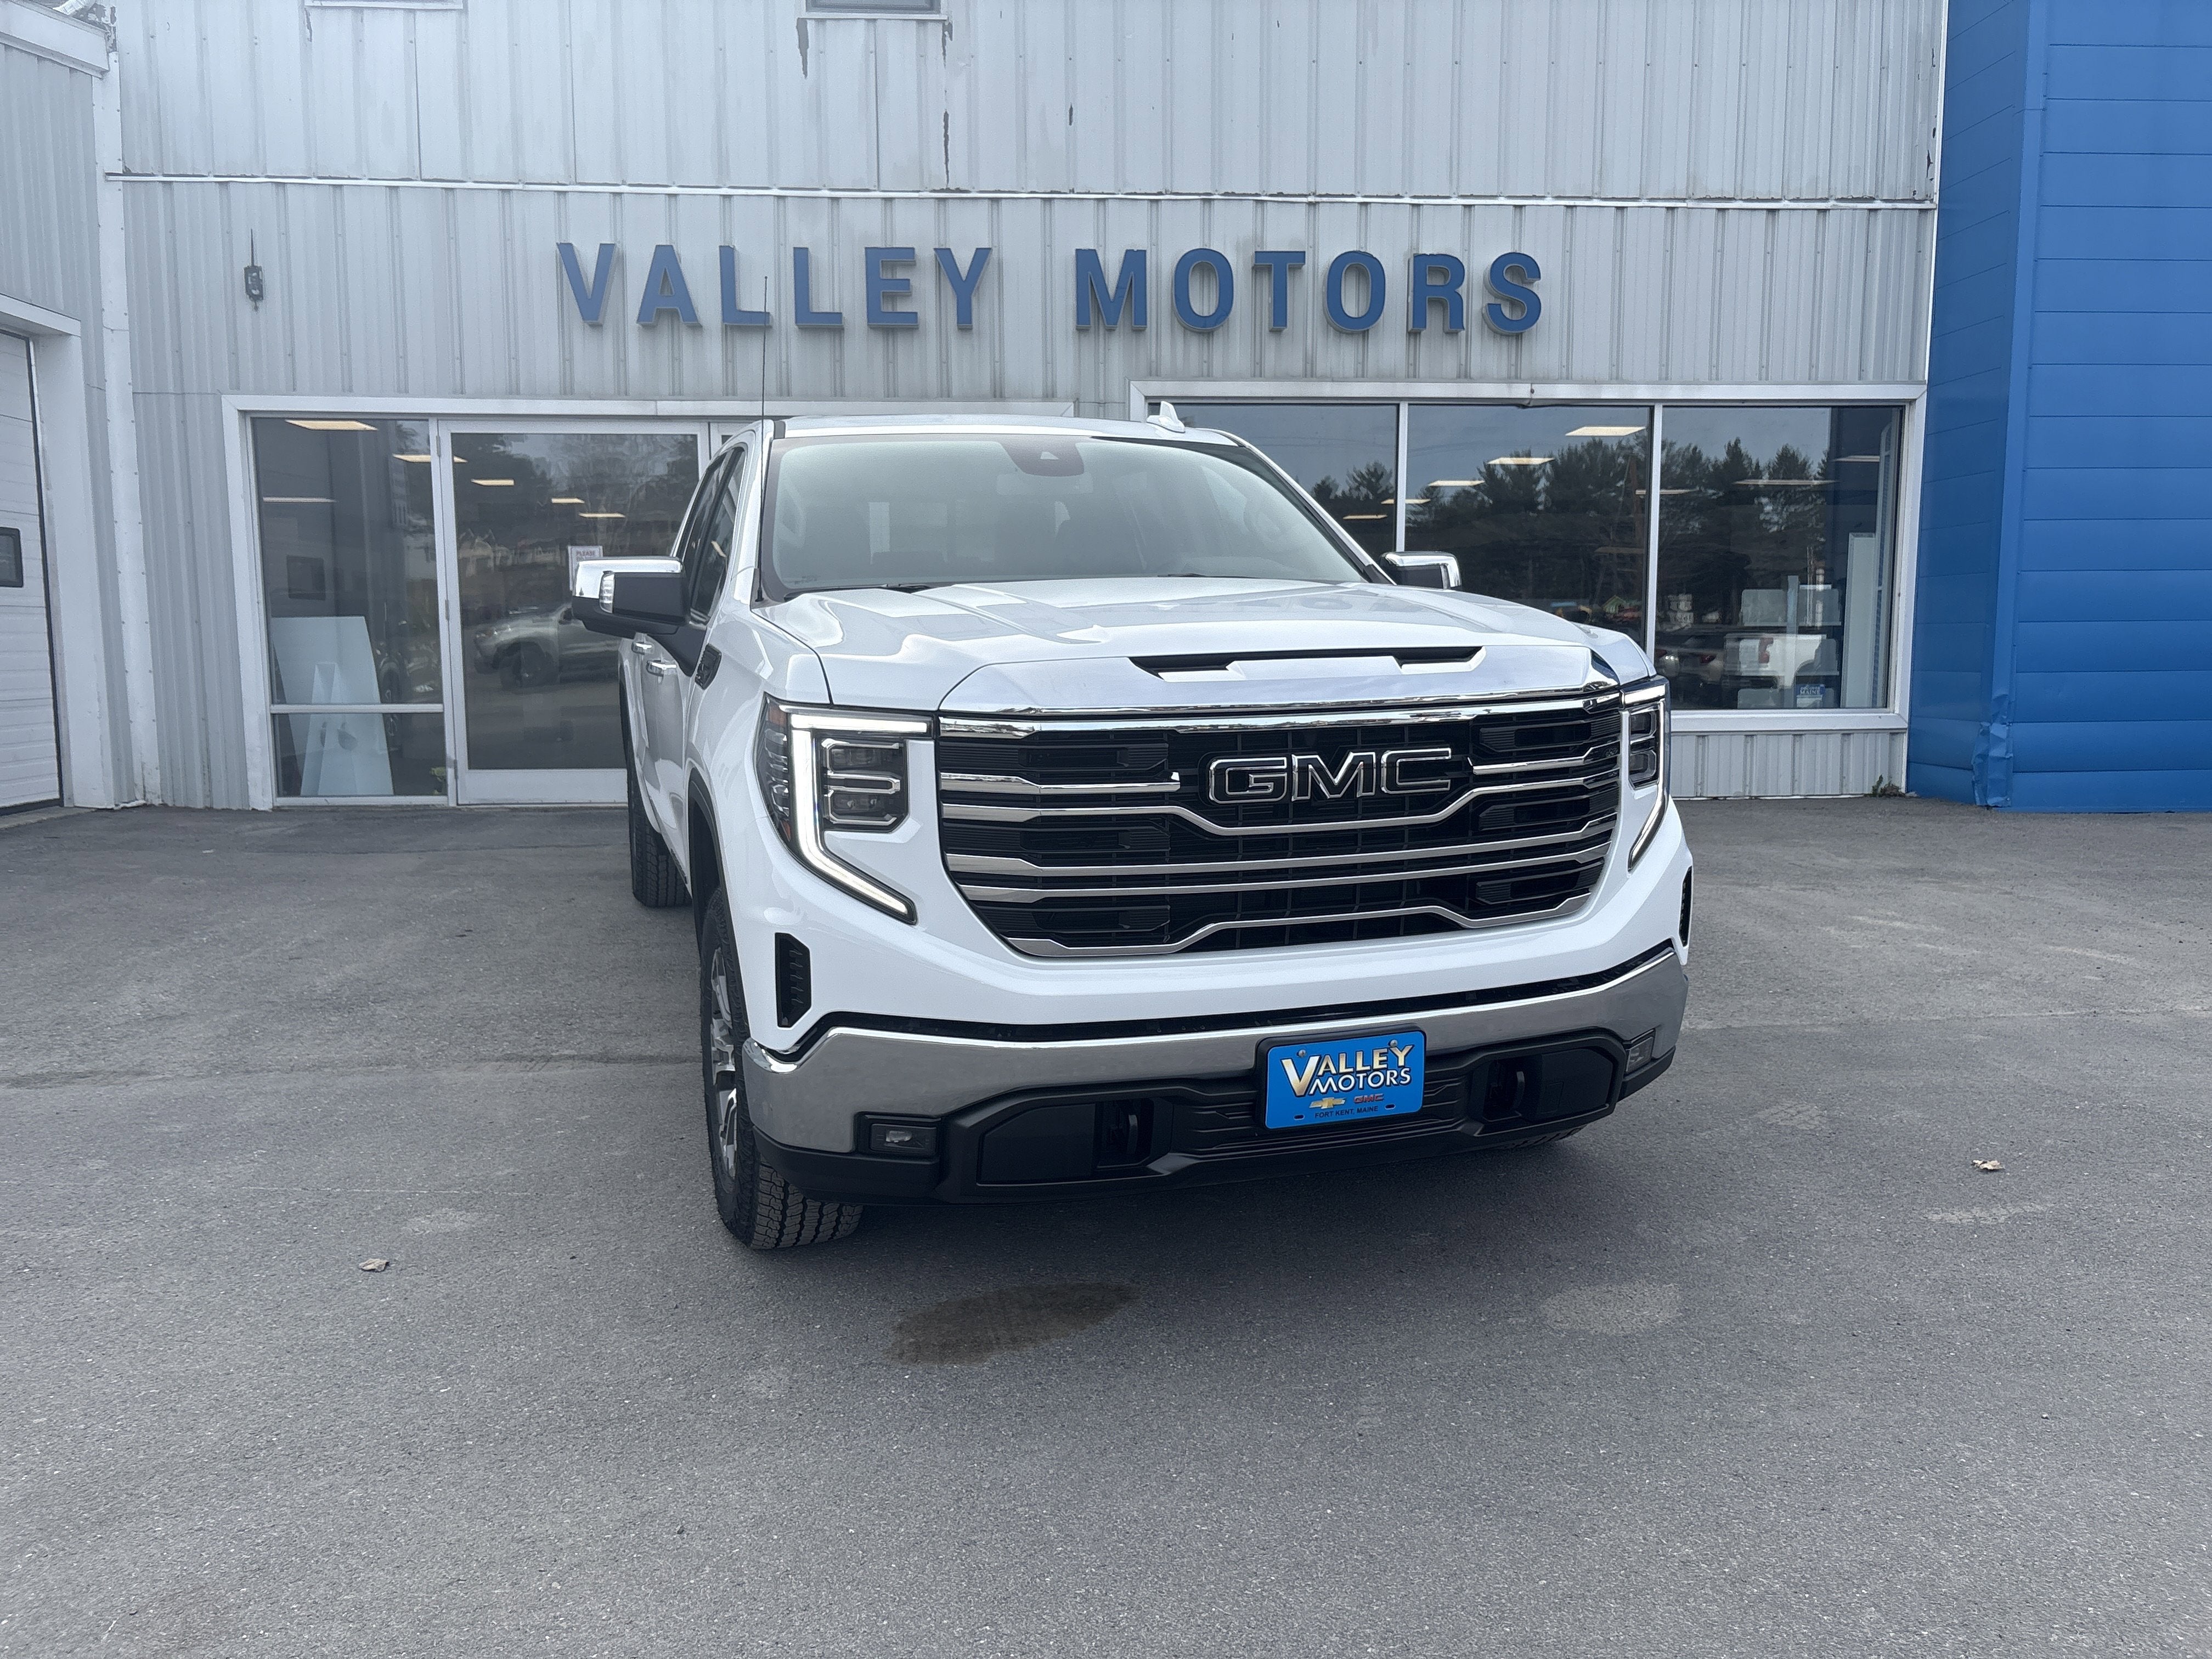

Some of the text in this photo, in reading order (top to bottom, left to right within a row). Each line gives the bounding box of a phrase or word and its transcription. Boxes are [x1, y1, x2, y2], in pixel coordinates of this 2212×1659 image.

[556, 242, 1542, 335] VALLEY MOTORS
[1209, 748, 1452, 804] GMC
[1280, 1045, 1414, 1097] VALLEY
[1308, 1067, 1412, 1096] MOTORS
[1314, 1110, 1334, 1119] FORT
[1357, 1105, 1379, 1114] MAINE
[1353, 1093, 1384, 1104] GMC
